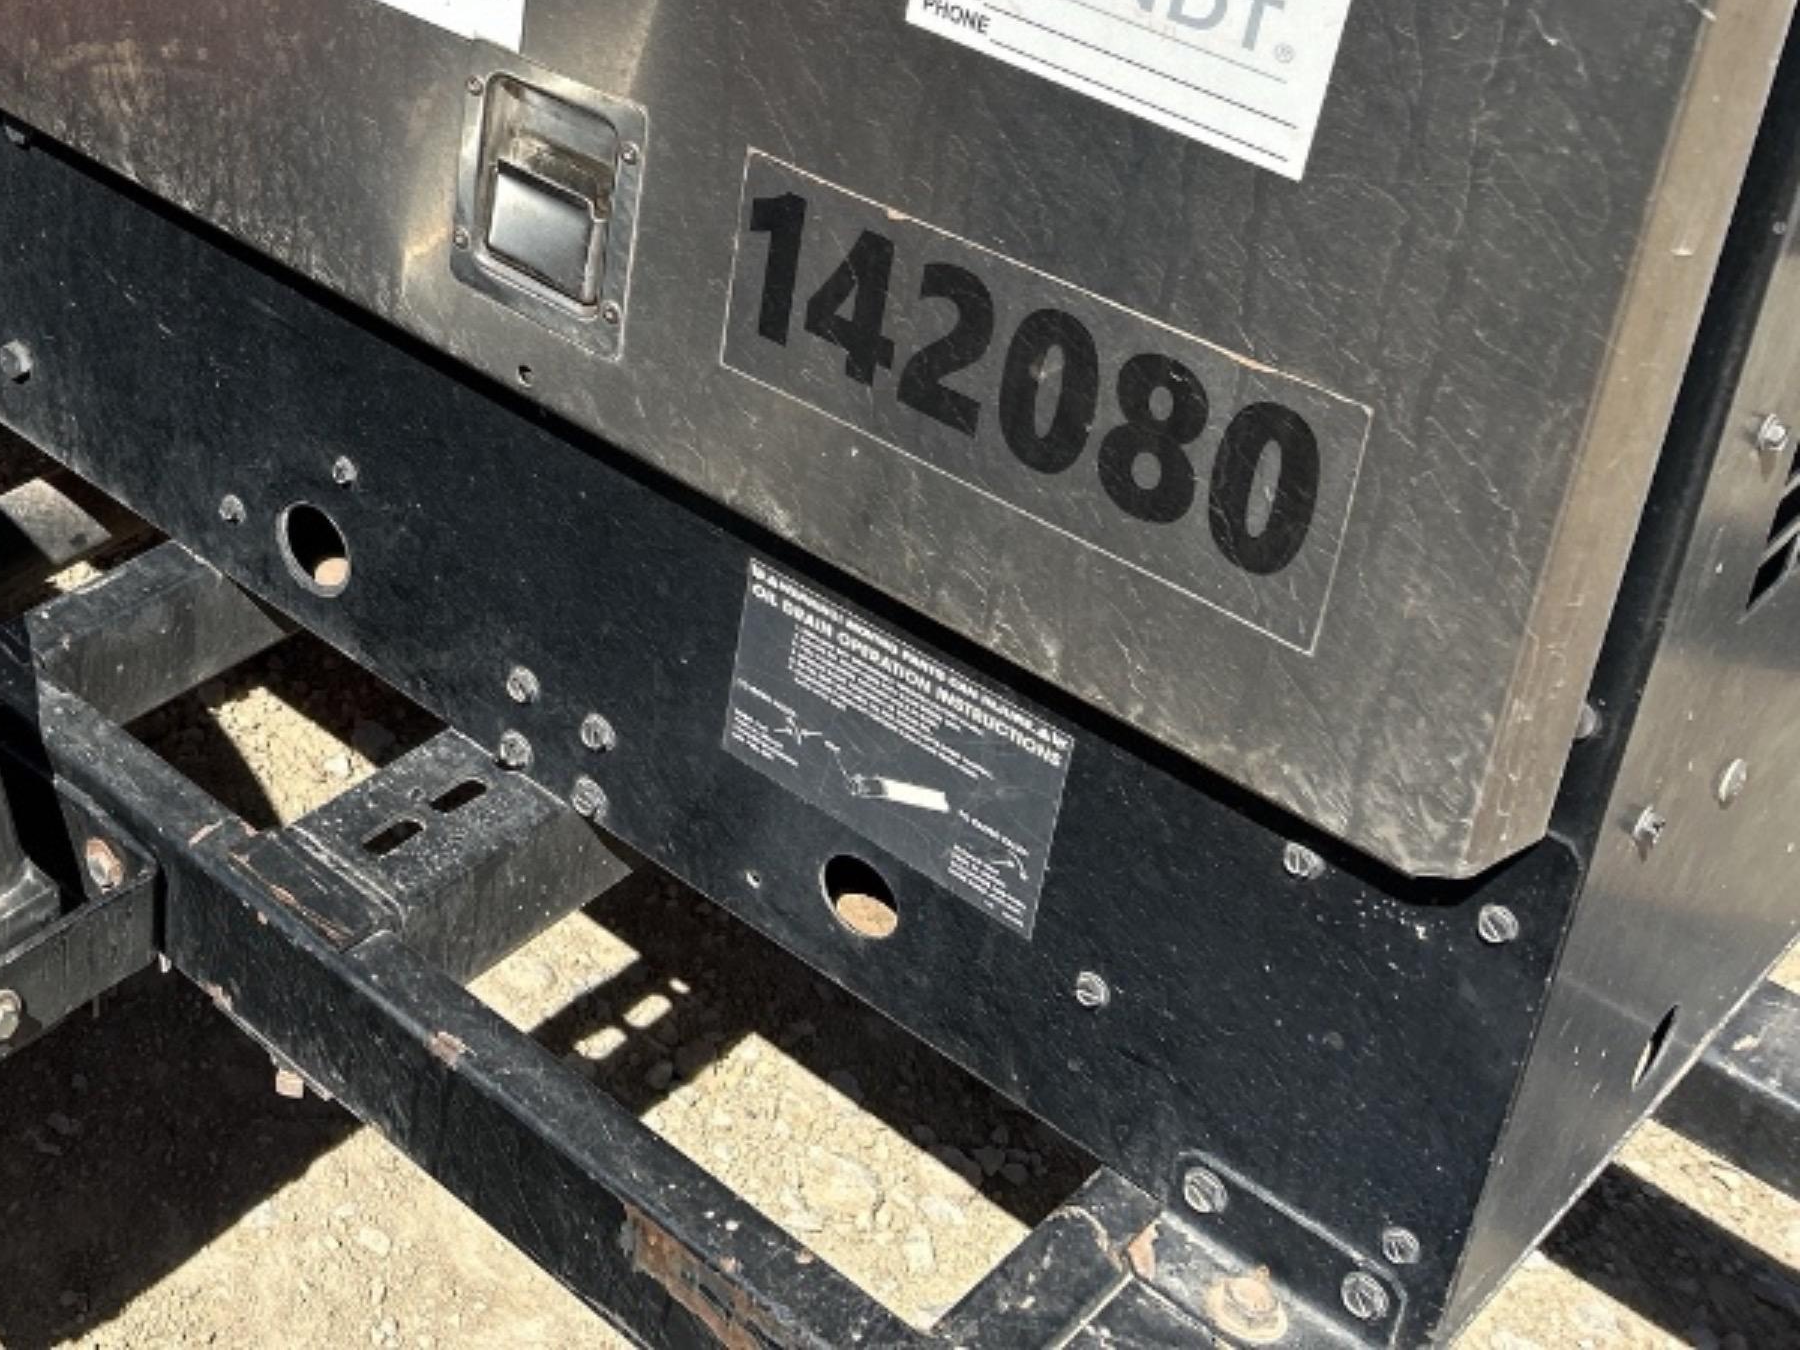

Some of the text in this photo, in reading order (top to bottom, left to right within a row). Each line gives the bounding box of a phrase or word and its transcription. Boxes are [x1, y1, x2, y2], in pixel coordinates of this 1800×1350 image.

[749, 191, 1320, 576] 142080
[752, 583, 1063, 767] OIL DRAIN OPERATION INSTRUCTIONS
